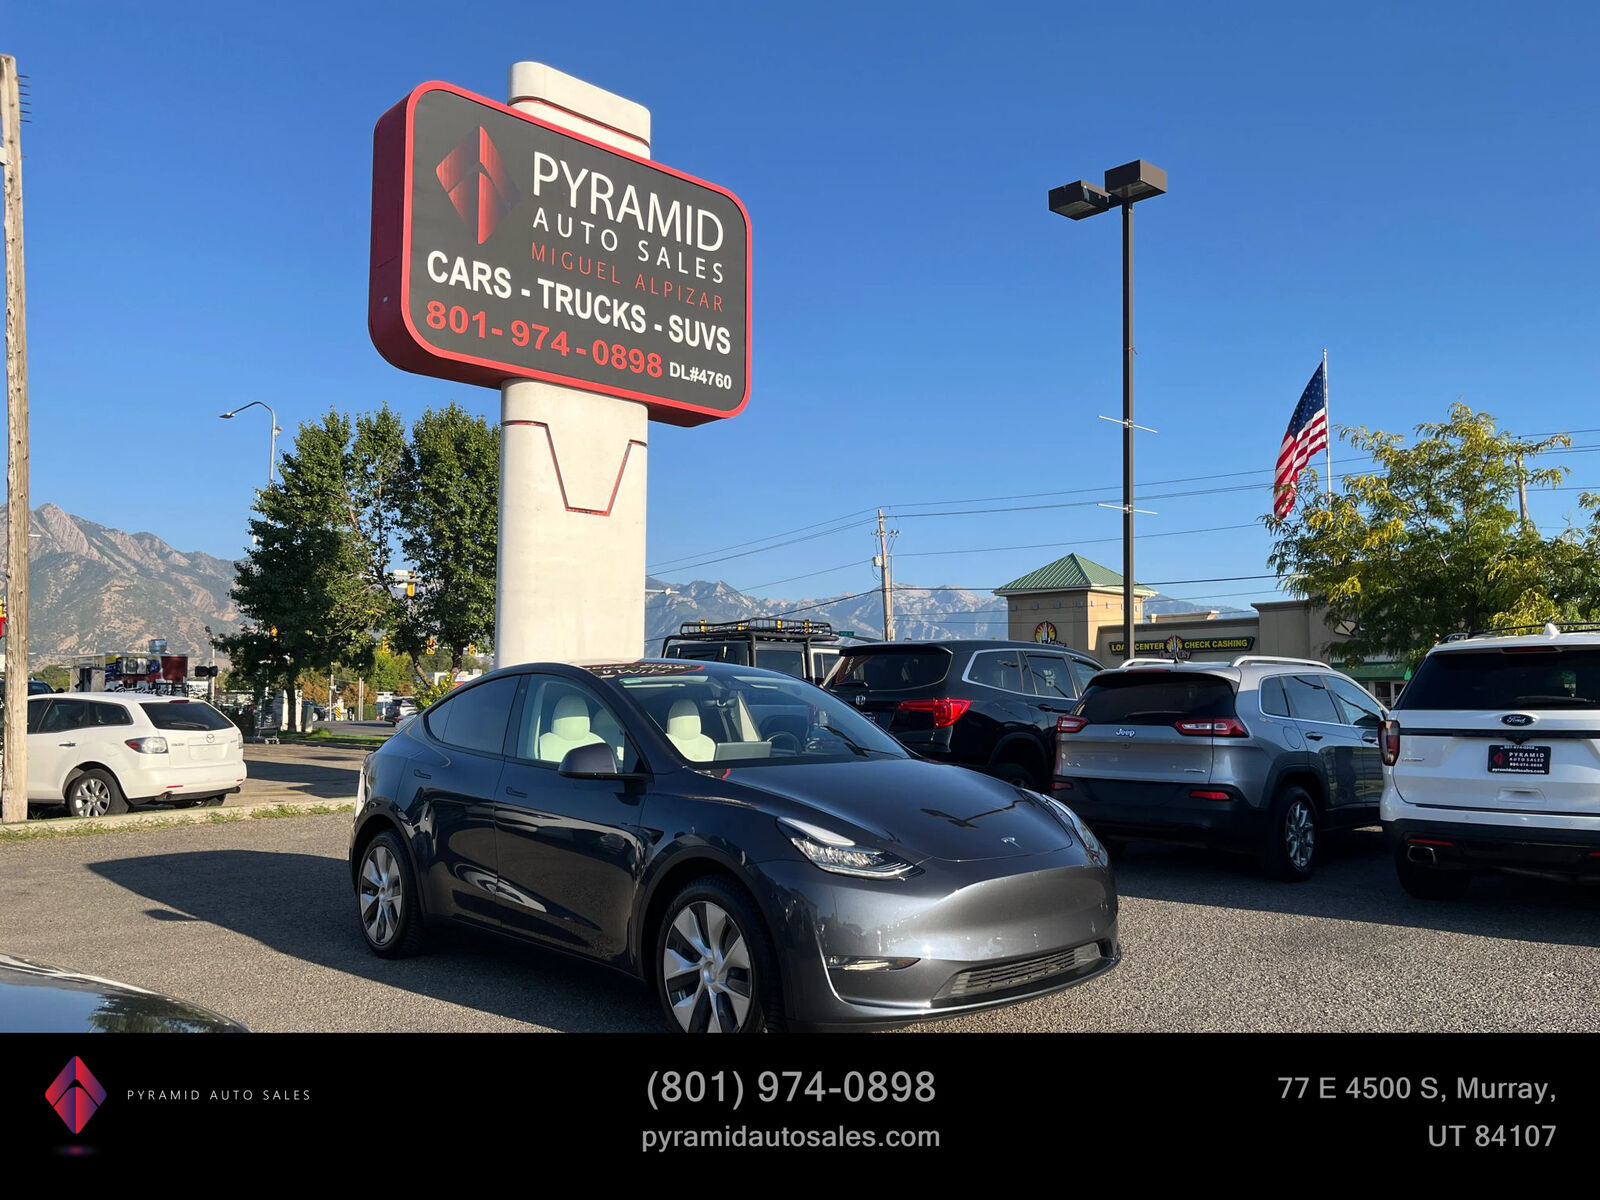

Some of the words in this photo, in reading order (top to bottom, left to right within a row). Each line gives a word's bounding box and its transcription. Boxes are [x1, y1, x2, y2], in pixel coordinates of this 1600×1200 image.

[533, 151, 724, 252] PYRAMID
[531, 242, 621, 285] MIGUEL
[635, 273, 723, 312] ALPIZAR
[533, 207, 618, 252] AUTO
[637, 240, 724, 284] SALES
[427, 250, 512, 299] CARS
[537, 277, 647, 334] TRUCKS
[668, 314, 731, 354] SUVS
[669, 361, 732, 389] DL#4760
[1135, 642, 1165, 651] CENTER
[1185, 640, 1211, 649] CHECK
[1212, 639, 1248, 648] CASHING
[1115, 728, 1136, 737] Jeep
